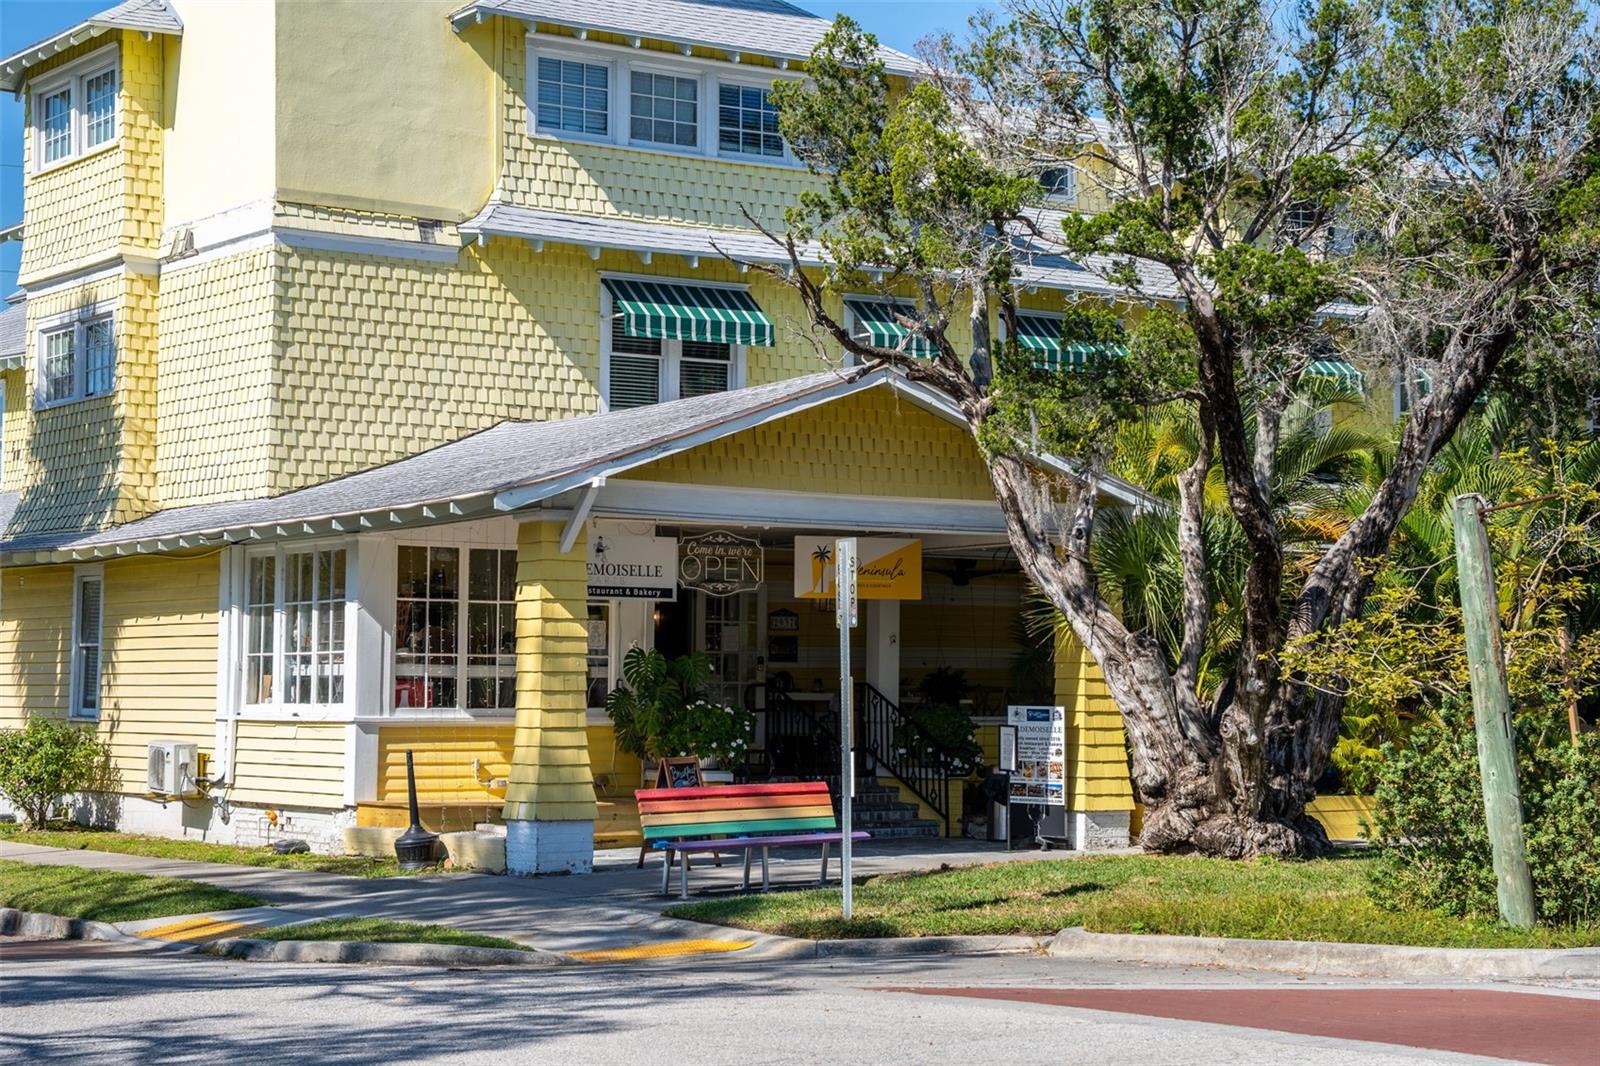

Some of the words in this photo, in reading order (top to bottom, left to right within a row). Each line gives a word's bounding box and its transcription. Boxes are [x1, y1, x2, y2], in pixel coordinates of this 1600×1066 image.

[687, 541, 713, 556] Come
[586, 562, 663, 577] EMOISELLE
[680, 555, 760, 582] OPEN
[588, 586, 623, 596] staurant
[625, 588, 631, 596] &
[633, 588, 662, 598] Bakery
